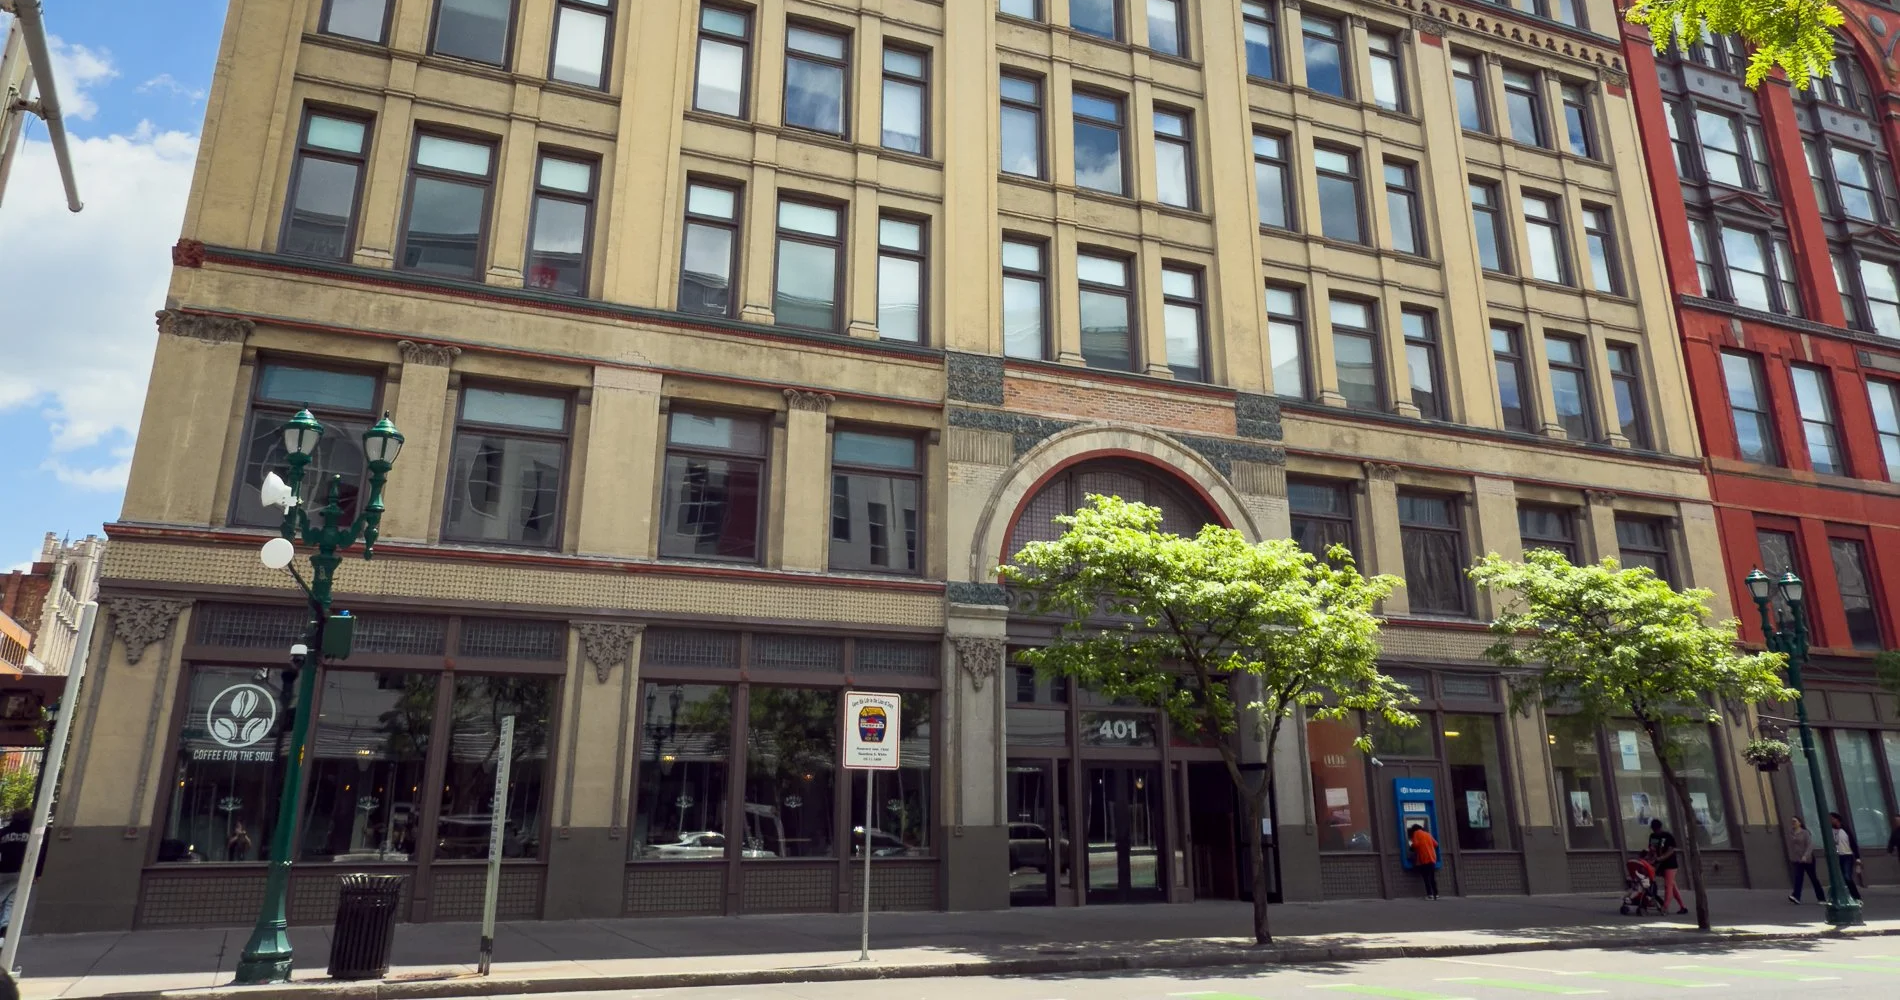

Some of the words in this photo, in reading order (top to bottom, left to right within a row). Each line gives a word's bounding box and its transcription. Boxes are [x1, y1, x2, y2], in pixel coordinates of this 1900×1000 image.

[1100, 720, 1137, 739] 401
[193, 749, 222, 760] COFFEE
[222, 750, 238, 761] FOR
[240, 750, 255, 761] THE
[255, 751, 274, 762] SOUL
